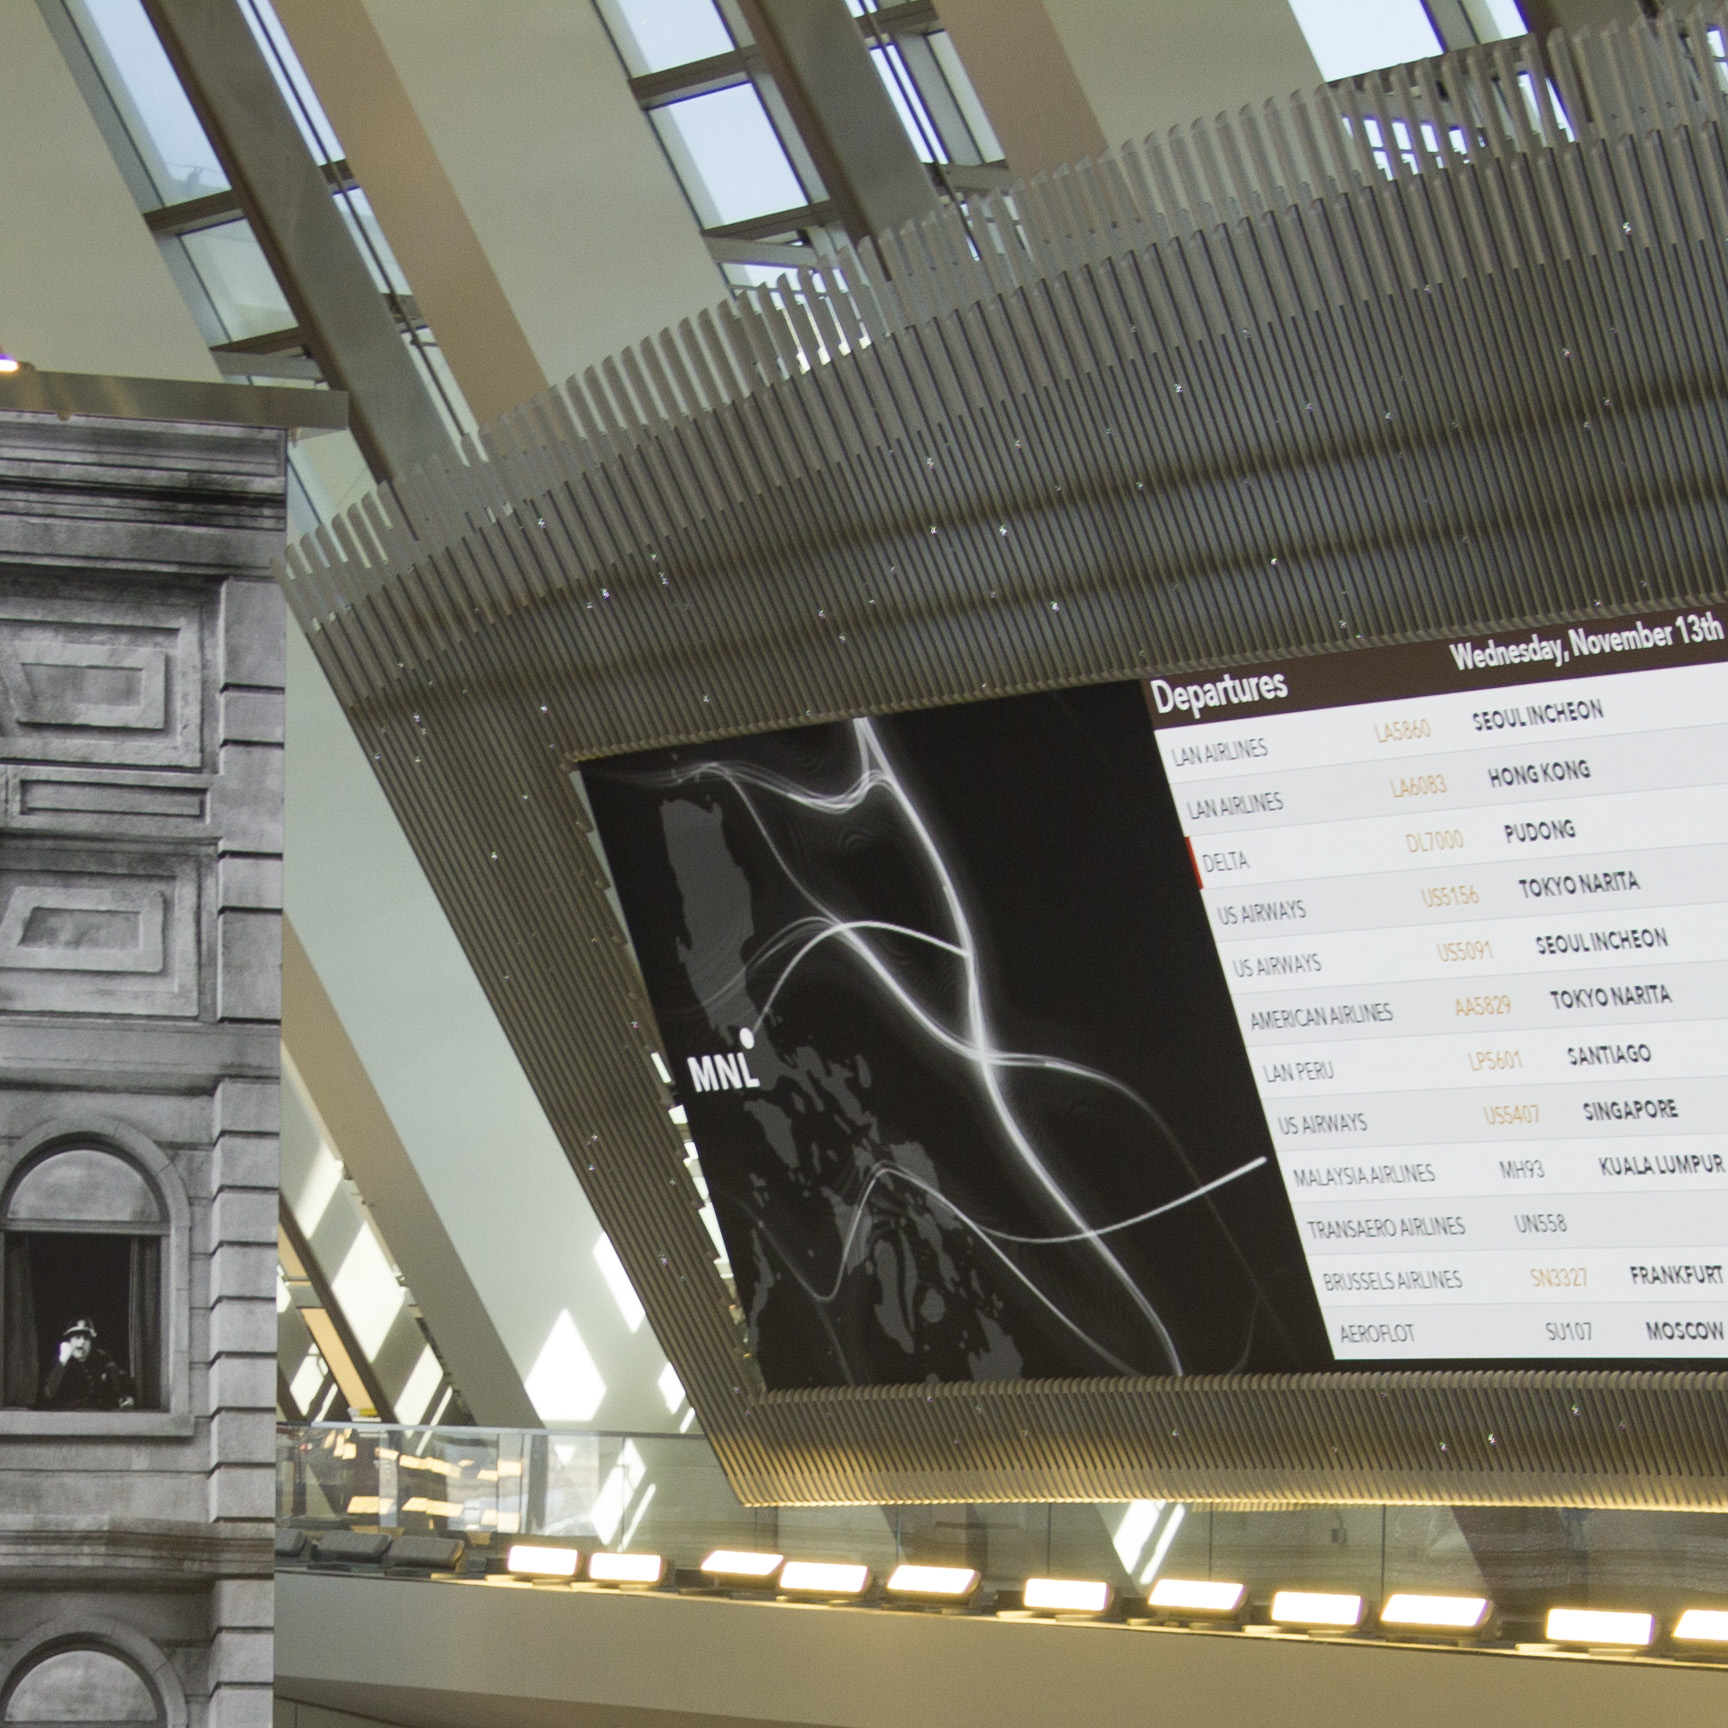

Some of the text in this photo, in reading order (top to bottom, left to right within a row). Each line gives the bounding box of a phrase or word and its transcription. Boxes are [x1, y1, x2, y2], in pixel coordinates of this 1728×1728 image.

[1150, 673, 1288, 719] Departures
[1449, 633, 1572, 673] Wednesday,
[1567, 621, 1673, 659] November
[1674, 612, 1725, 643] 13th
[1171, 746, 1202, 767] LAN
[1204, 737, 1268, 762] AIRLINES
[1373, 717, 1431, 743] LA5860
[1471, 707, 1527, 731] SEOUL
[1525, 698, 1604, 725] INCHEON
[1186, 799, 1218, 820] LAN
[1219, 791, 1284, 815] AIRLINES
[1389, 773, 1447, 798] LA6083
[1487, 763, 1540, 787] HONG
[1539, 758, 1591, 782] KONG
[1202, 850, 1249, 873] DELTA
[1404, 828, 1464, 853] DL7000
[1503, 818, 1576, 843] PUDONG
[1217, 905, 1238, 925] US
[1241, 899, 1306, 922] AIRWAYS
[1420, 884, 1480, 907] US5156
[1517, 874, 1577, 898] TOKYO
[1577, 869, 1640, 893] NARITA
[1233, 958, 1253, 978] US
[1256, 952, 1321, 975] AIRWAYS
[1436, 939, 1493, 962] US5091
[1535, 933, 1590, 955] SEOUL
[1589, 927, 1668, 951] INCHEON
[1251, 1007, 1327, 1029] AMERICAN
[1329, 1002, 1393, 1024] AIRLINES
[1454, 994, 1512, 1016] AA5829
[1549, 987, 1609, 1009] TOKYO
[1609, 983, 1672, 1006] NARITA
[686, 1051, 761, 1093] MNL
[1263, 1063, 1294, 1083] LAN
[1295, 1060, 1334, 1080] PERU
[1467, 1049, 1522, 1071] LP5601
[1566, 1043, 1652, 1066] SANTIAGO
[1278, 1115, 1299, 1135] US
[1302, 1112, 1367, 1133] AIRWAYS
[1483, 1103, 1539, 1125] US5407
[1582, 1098, 1679, 1121] SINGAPORE
[1293, 1166, 1368, 1186] MALAYSIA
[1370, 1163, 1435, 1183] AIRLINES
[1498, 1158, 1545, 1178] MH93
[1598, 1156, 1655, 1176] KUALA
[1654, 1153, 1725, 1174] LUMPUR
[1307, 1217, 1396, 1238] TRANSAERO
[1400, 1215, 1466, 1236] AIRLINES
[1513, 1212, 1567, 1233] UN558
[1322, 1271, 1395, 1291] BRUSSELS
[1397, 1269, 1463, 1289] AIRLINES
[1529, 1266, 1587, 1287] SN3327
[1629, 1264, 1723, 1284] FRANKFURT
[1339, 1323, 1414, 1344] AEROFLOT
[1544, 1320, 1592, 1341] SU107
[1644, 1320, 1724, 1340] MOSCOW
